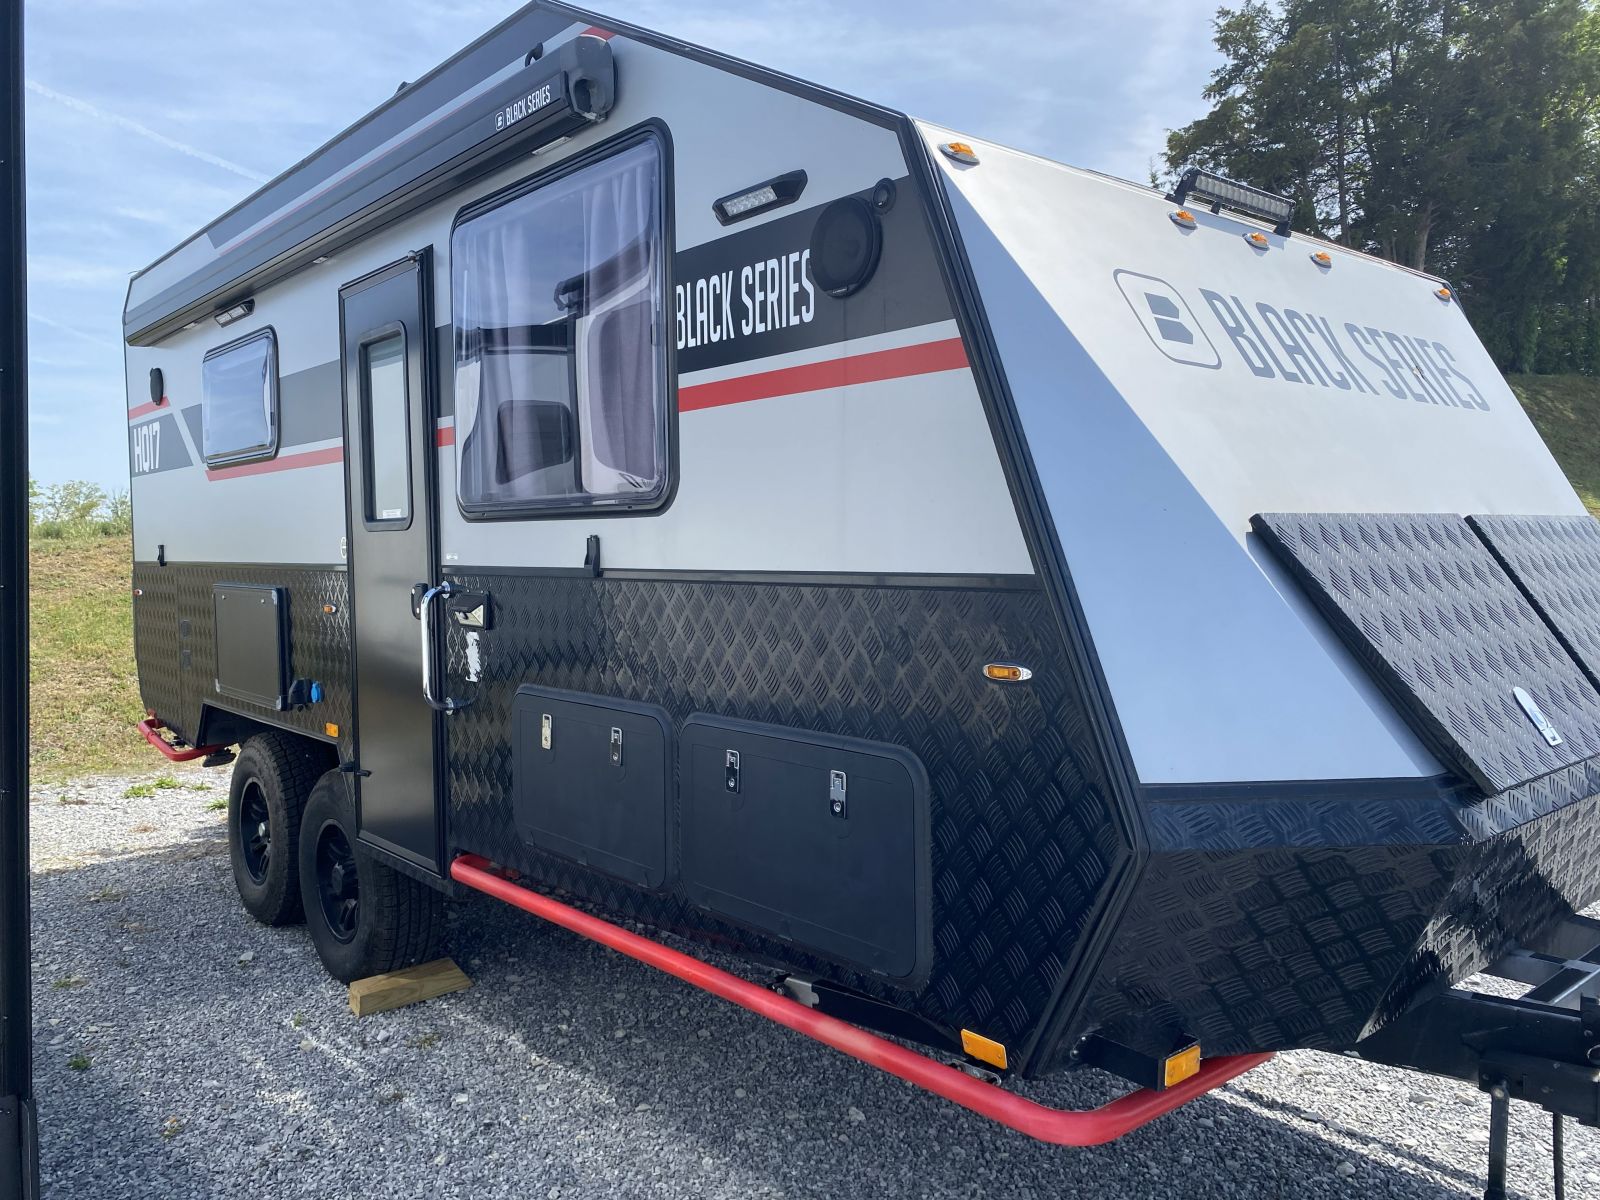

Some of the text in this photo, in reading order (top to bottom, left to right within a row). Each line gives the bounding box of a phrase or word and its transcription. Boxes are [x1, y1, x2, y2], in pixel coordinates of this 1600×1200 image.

[505, 98, 527, 126] BLACK
[527, 84, 551, 113] SERIES
[676, 248, 815, 350] BLACK SERIES
[1198, 287, 1381, 396] BLACK
[1344, 322, 1491, 412] SERIES
